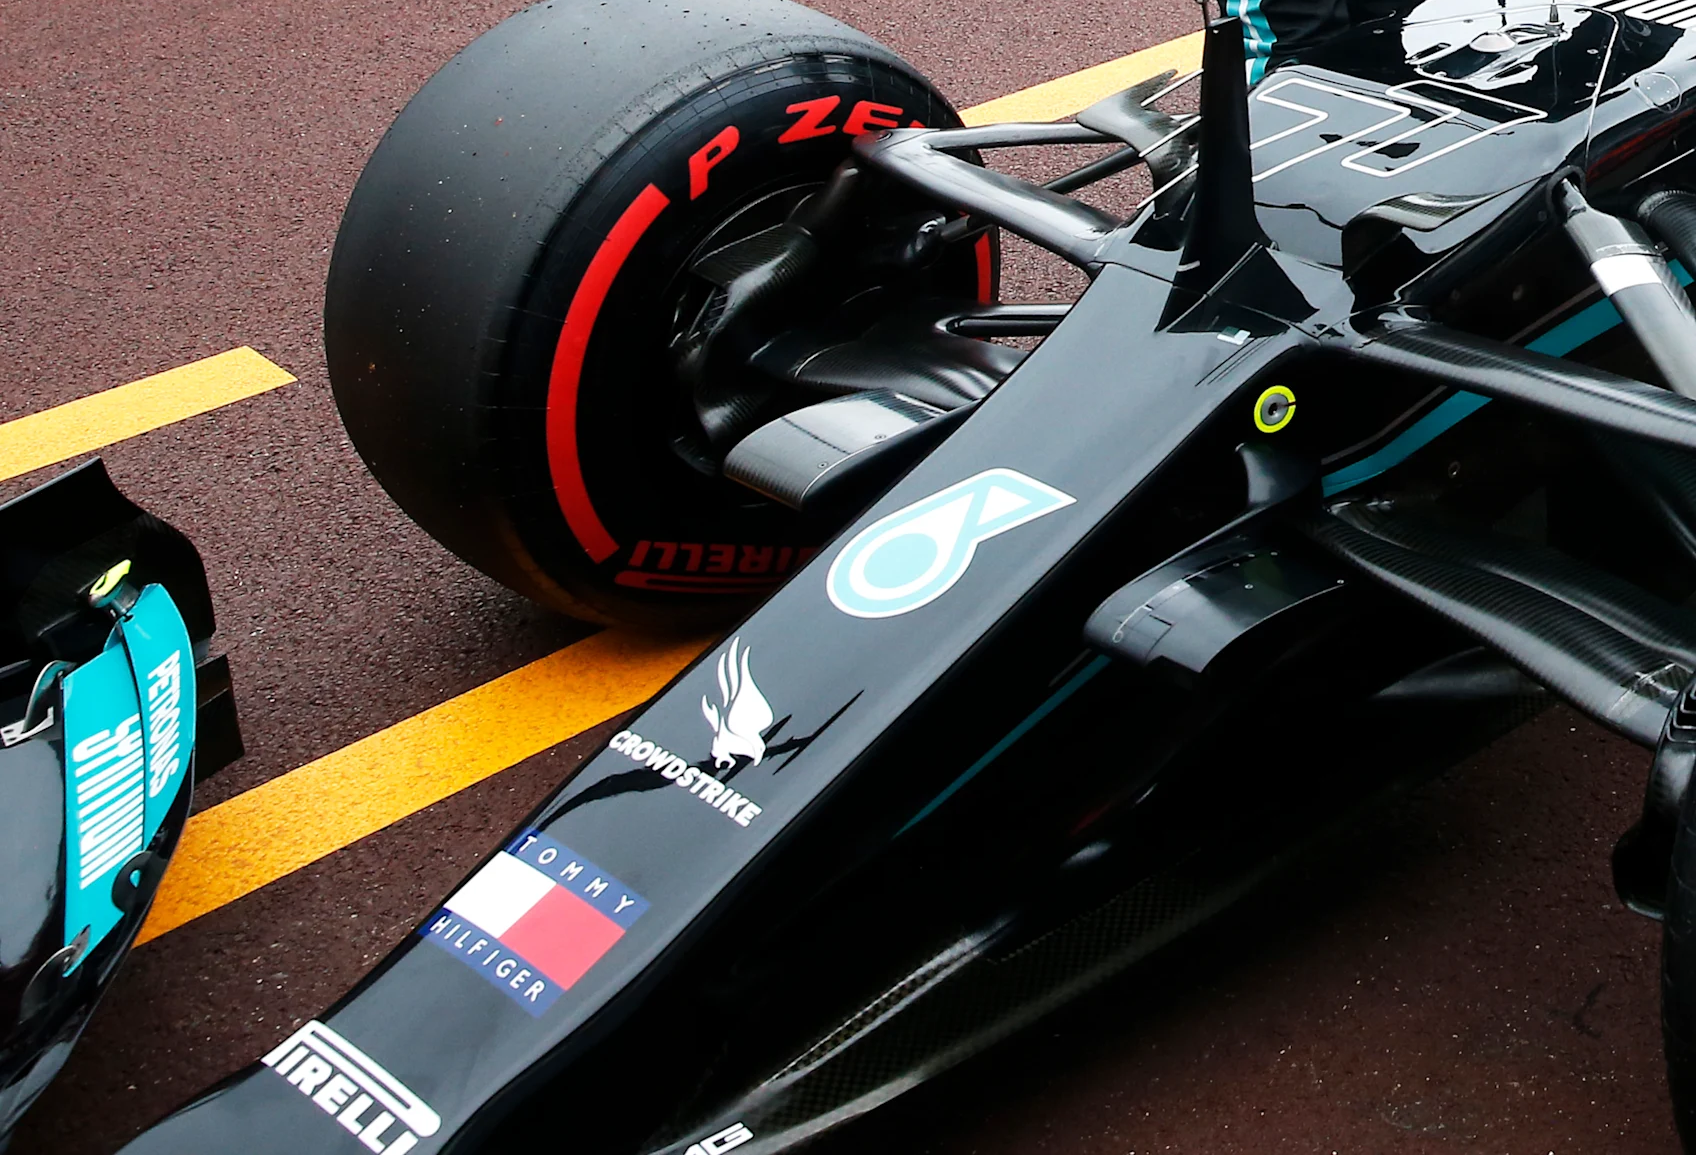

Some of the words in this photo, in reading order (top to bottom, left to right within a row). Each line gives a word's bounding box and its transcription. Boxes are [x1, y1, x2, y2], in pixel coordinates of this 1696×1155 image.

[688, 125, 740, 200] P
[778, 95, 928, 146] ZE
[147, 649, 181, 798] PETRONAS
[608, 729, 764, 828] CROWDSTRIKE
[517, 835, 636, 915] TOMMY
[429, 915, 546, 1004] HILFIGER
[259, 1018, 443, 1155] PIRELLI
